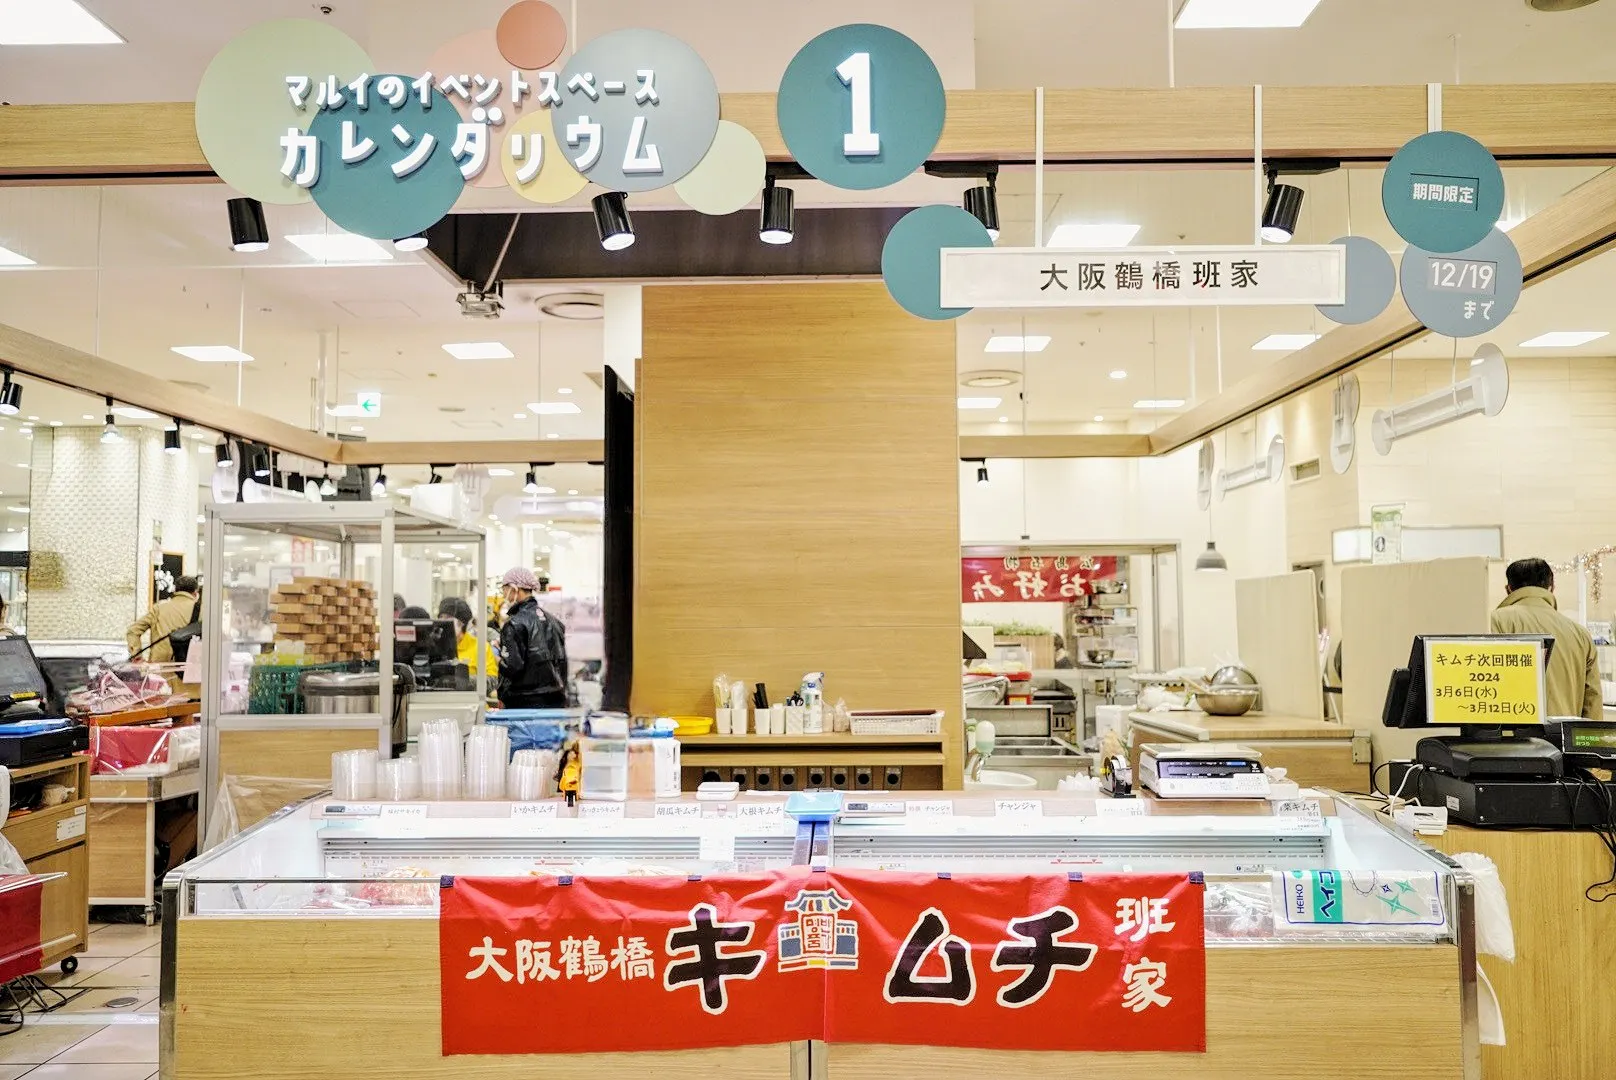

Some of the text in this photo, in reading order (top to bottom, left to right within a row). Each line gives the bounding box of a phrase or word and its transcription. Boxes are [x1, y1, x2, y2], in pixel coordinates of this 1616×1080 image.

[284, 69, 660, 109] マルイのイベントスペース
[836, 52, 881, 157] 1
[279, 107, 663, 188] カレンダリウム
[1413, 182, 1475, 204] 期間限定
[1040, 260, 1259, 291] 大阪鶴橋班家
[1431, 261, 1494, 290] 12/19
[1463, 300, 1494, 320] まで
[1436, 653, 1533, 667] キムチ次回開催
[1469, 672, 1500, 682] 2024
[1436, 686, 1497, 699] 3月6日(水)
[1295, 883, 1305, 914] HEIKO
[465, 936, 655, 984] 大阪鶴橋
